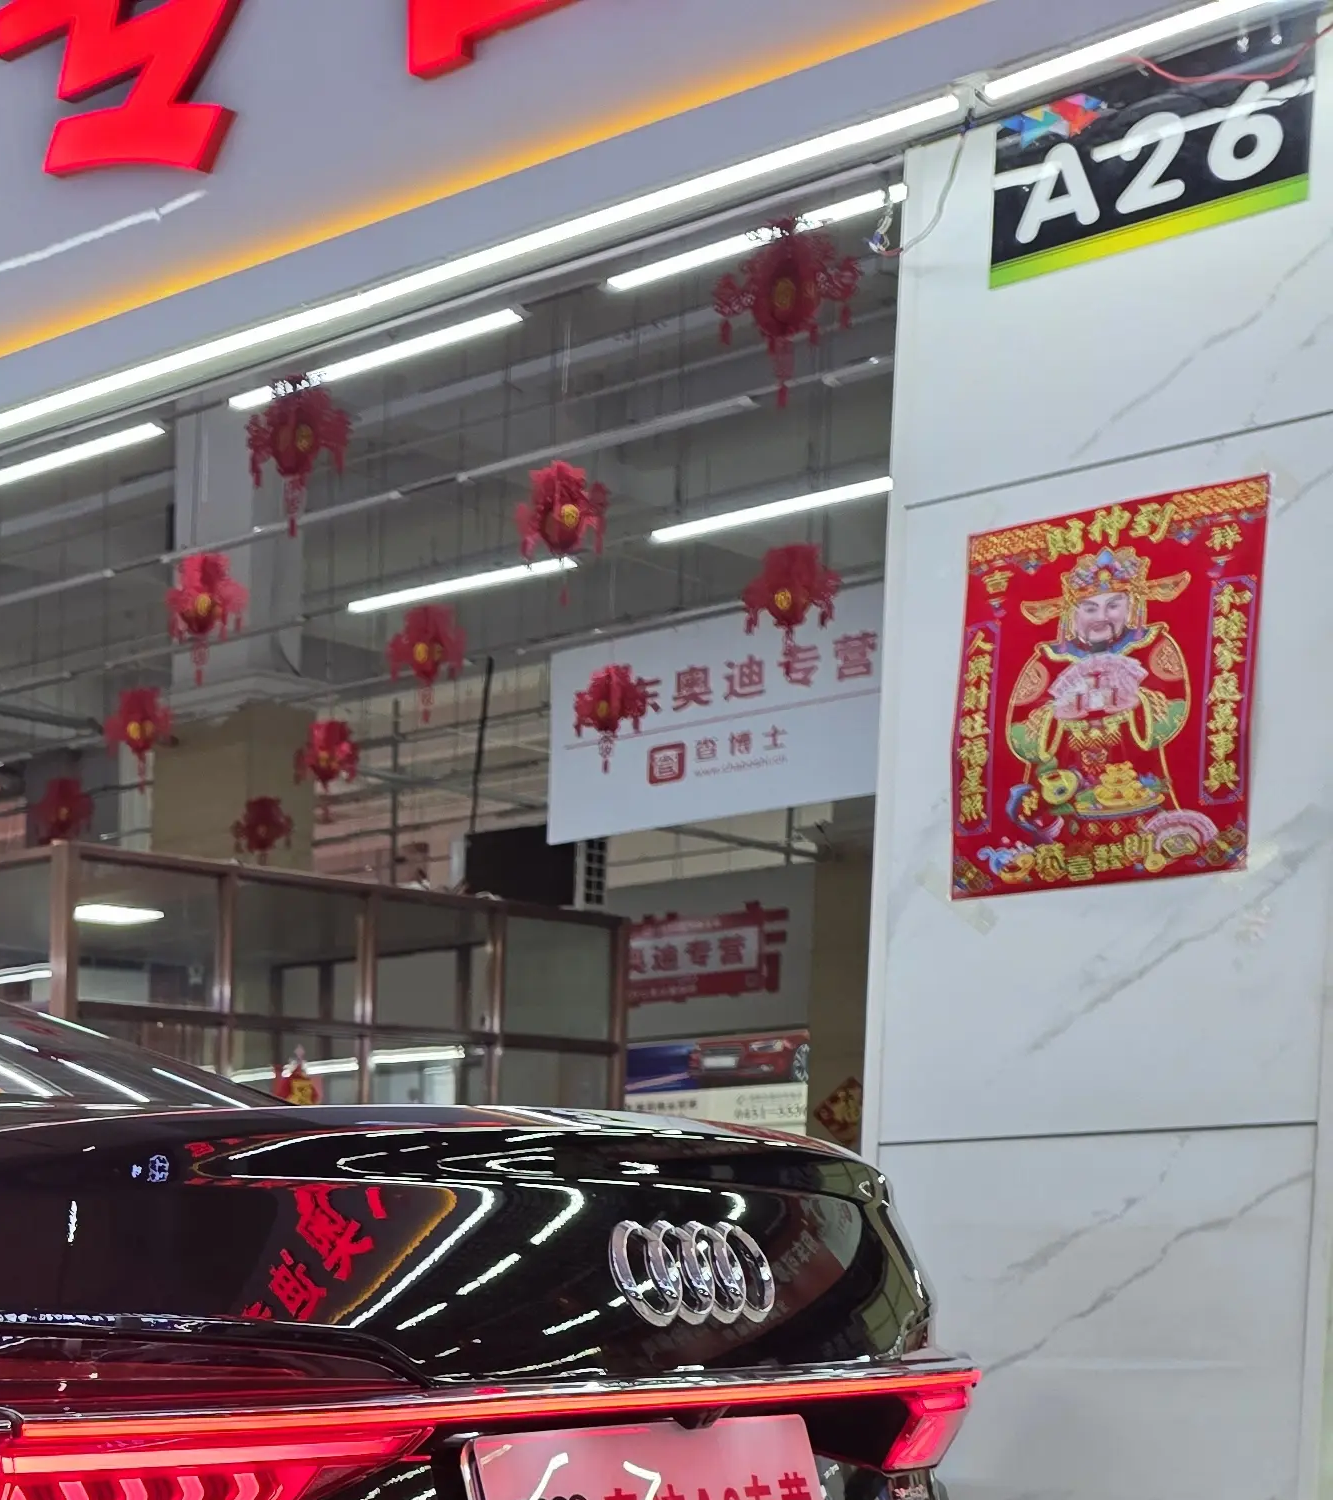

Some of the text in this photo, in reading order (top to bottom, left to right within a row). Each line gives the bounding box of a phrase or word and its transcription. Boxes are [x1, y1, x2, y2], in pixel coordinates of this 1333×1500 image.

[1014, 79, 1284, 244] A26
[629, 629, 879, 712] 东奥迪专营
